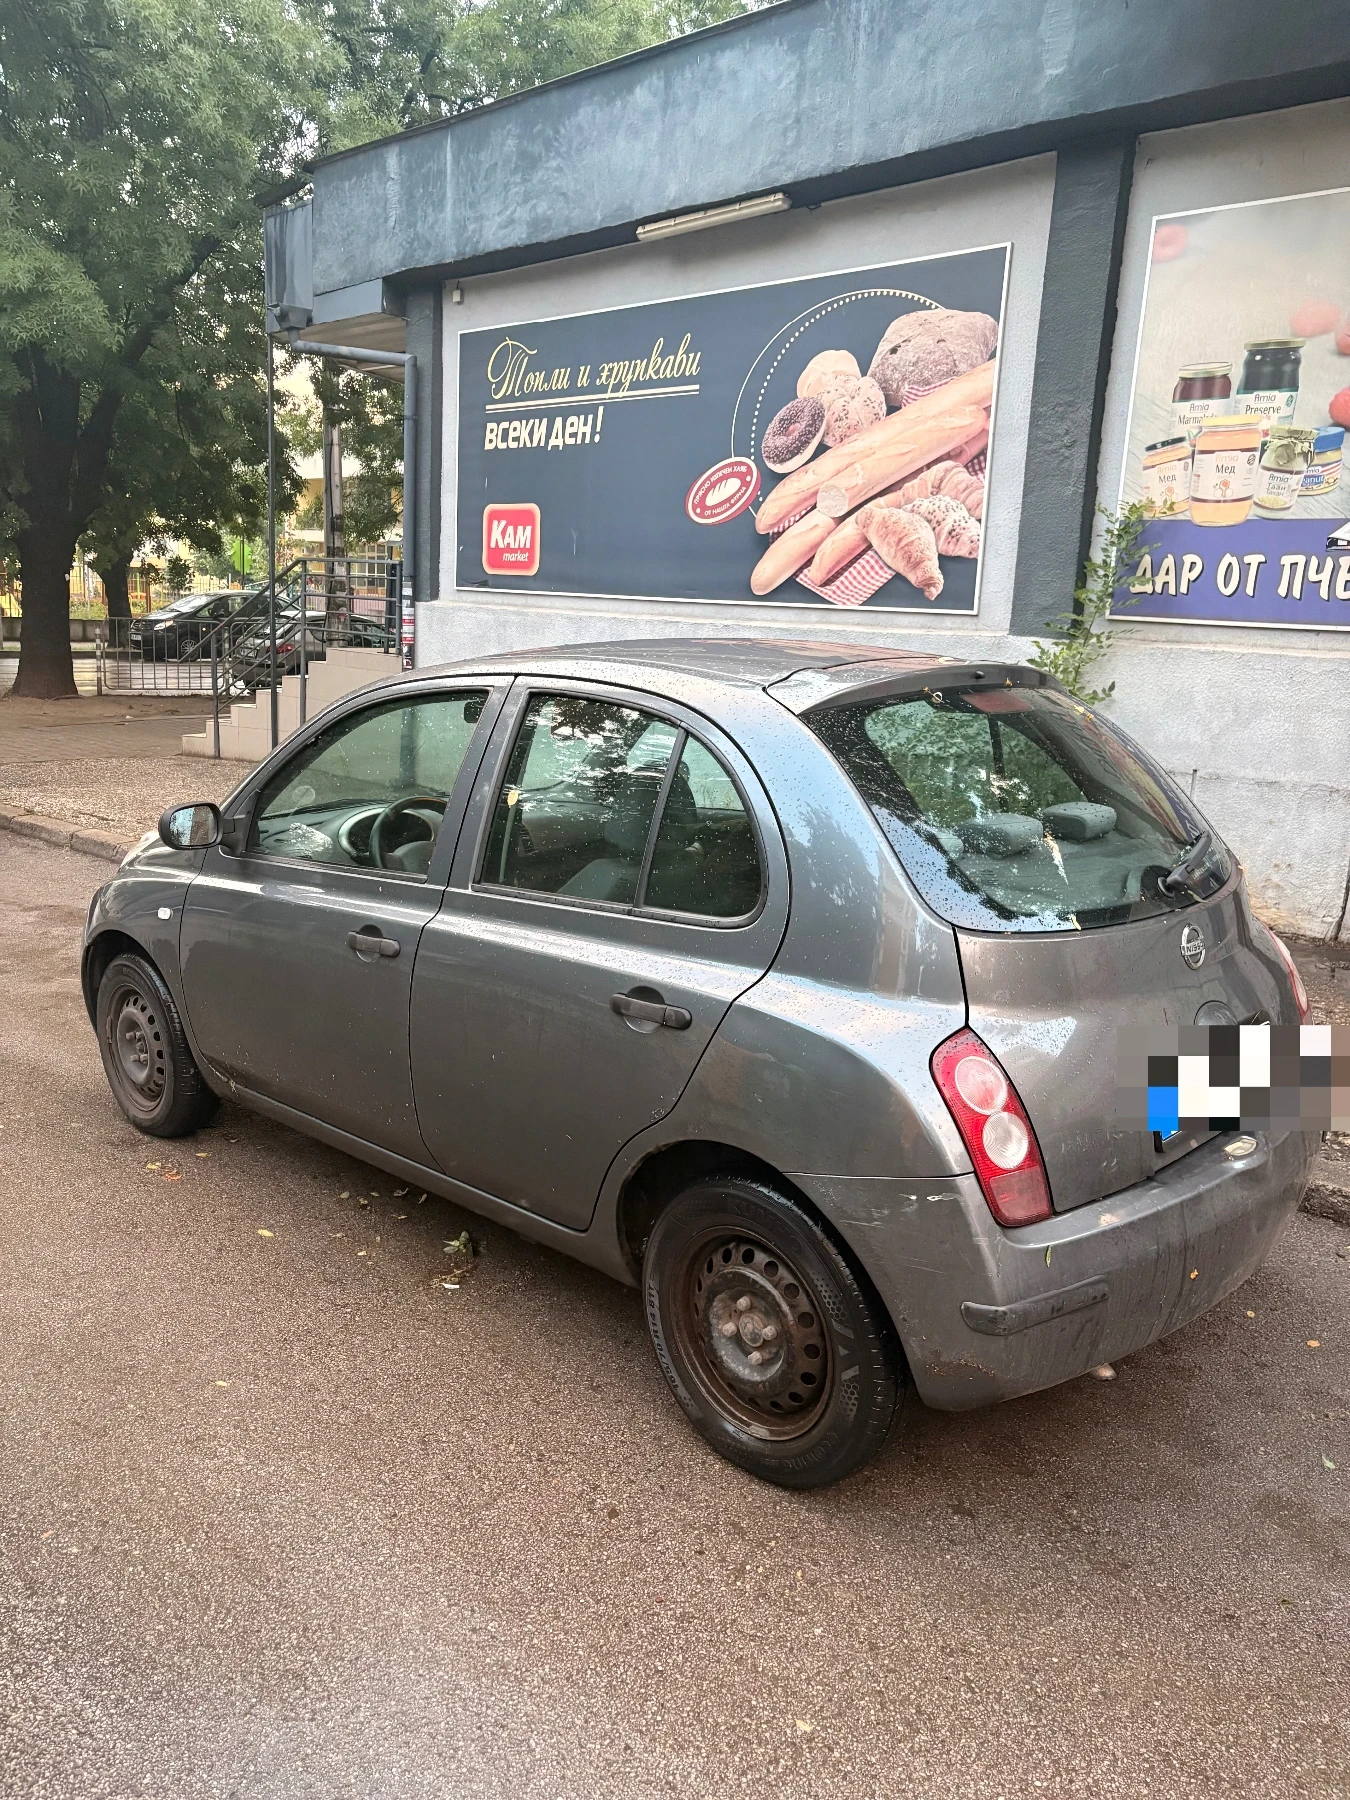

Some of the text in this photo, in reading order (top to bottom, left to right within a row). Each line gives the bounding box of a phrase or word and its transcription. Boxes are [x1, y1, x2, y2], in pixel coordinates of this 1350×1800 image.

[487, 332, 702, 400] Топли и хрупкави
[1245, 404, 1281, 414] Preserve
[1177, 413, 1218, 425] Marma
[1215, 464, 1236, 475] Мед
[1158, 473, 1177, 484] Мед
[502, 551, 529, 562] market
[1129, 553, 1205, 597] ДАР
[1216, 552, 1268, 599] ОТ
